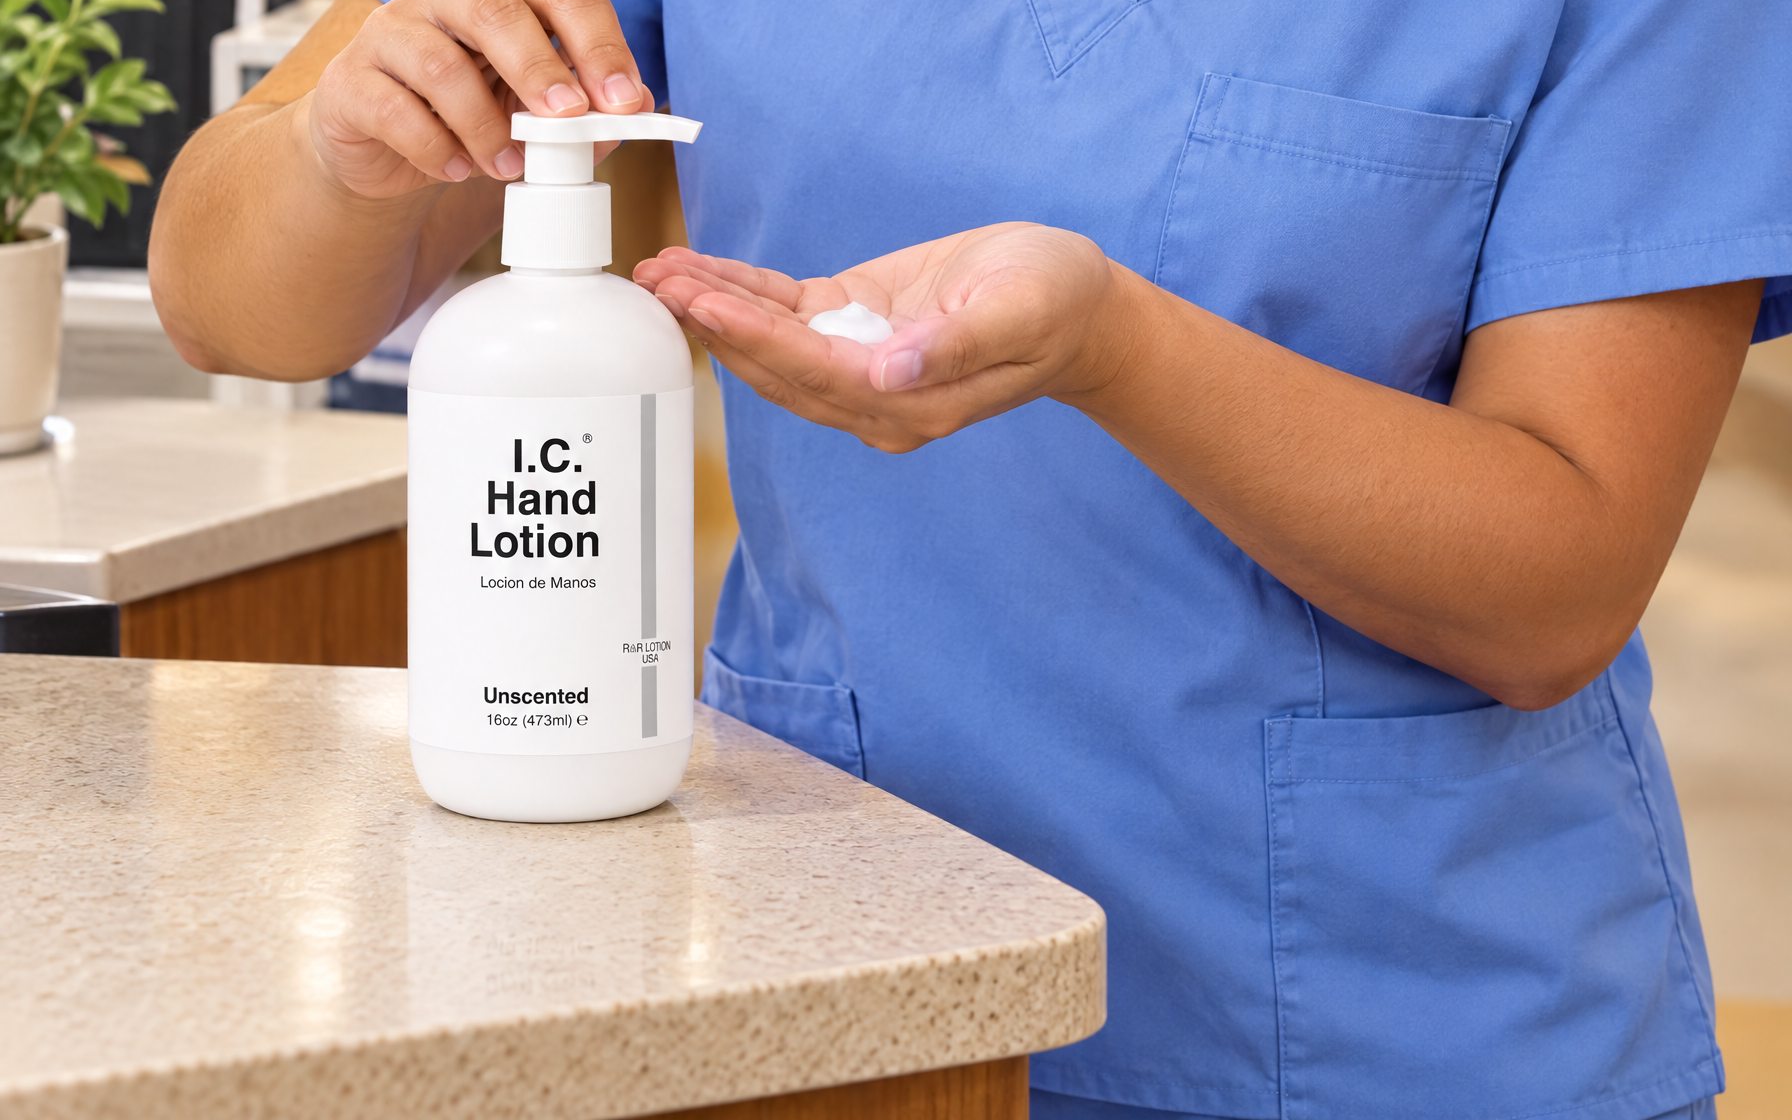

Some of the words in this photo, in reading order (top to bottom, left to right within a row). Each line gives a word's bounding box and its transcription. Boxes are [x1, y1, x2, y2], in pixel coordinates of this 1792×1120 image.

[487, 480, 596, 516] Hand
[470, 522, 600, 559] Lotion
[480, 575, 524, 589] Locion
[528, 576, 546, 590] de
[550, 576, 597, 589] Manos
[645, 640, 672, 653] LOTION
[641, 653, 659, 664] USA
[483, 686, 589, 705] Unscented
[487, 713, 518, 727] 16oz
[522, 714, 573, 729] (473ml)
